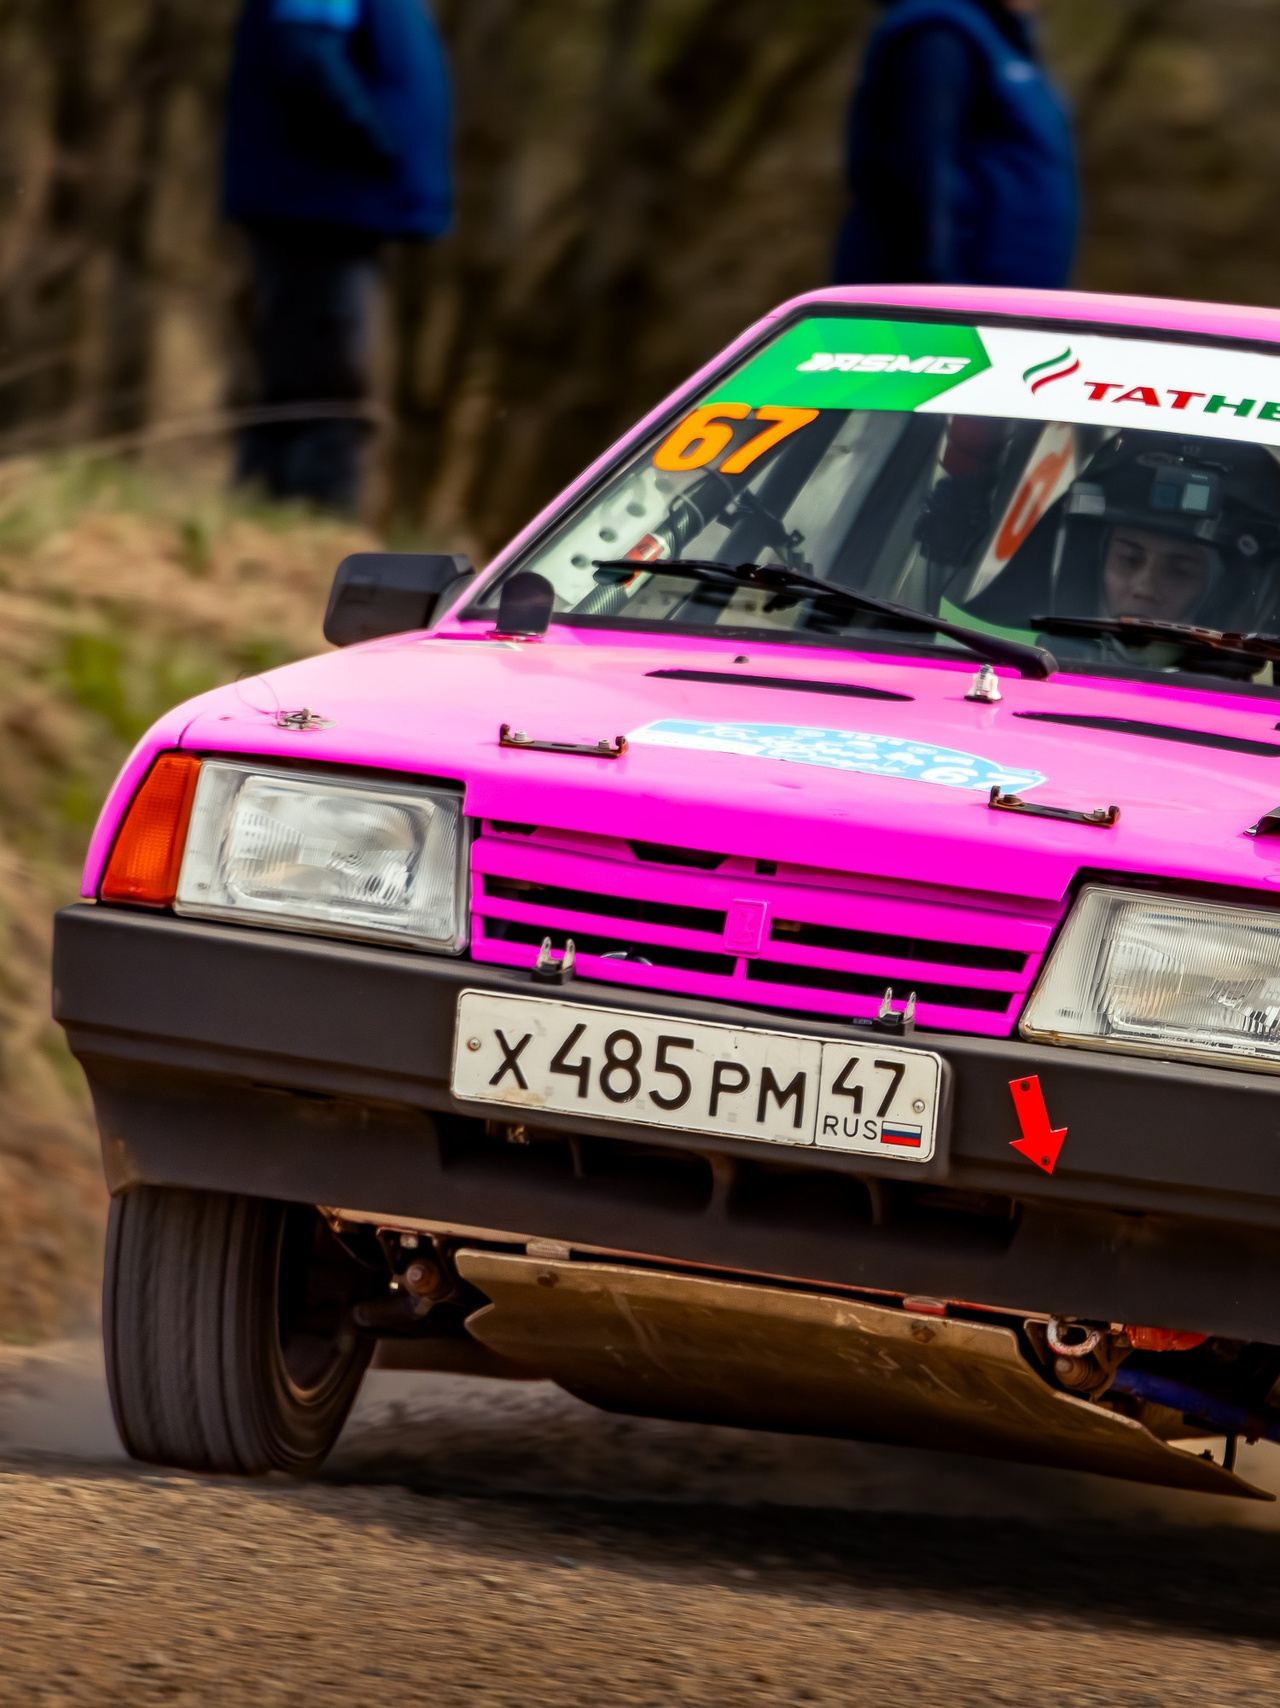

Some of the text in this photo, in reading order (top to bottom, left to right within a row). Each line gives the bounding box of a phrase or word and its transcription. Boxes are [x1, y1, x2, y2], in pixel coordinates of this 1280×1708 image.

[653, 403, 820, 475] 67
[920, 766, 1035, 789] 67
[831, 1057, 907, 1118] 47
[822, 1116, 878, 1141] RUS
